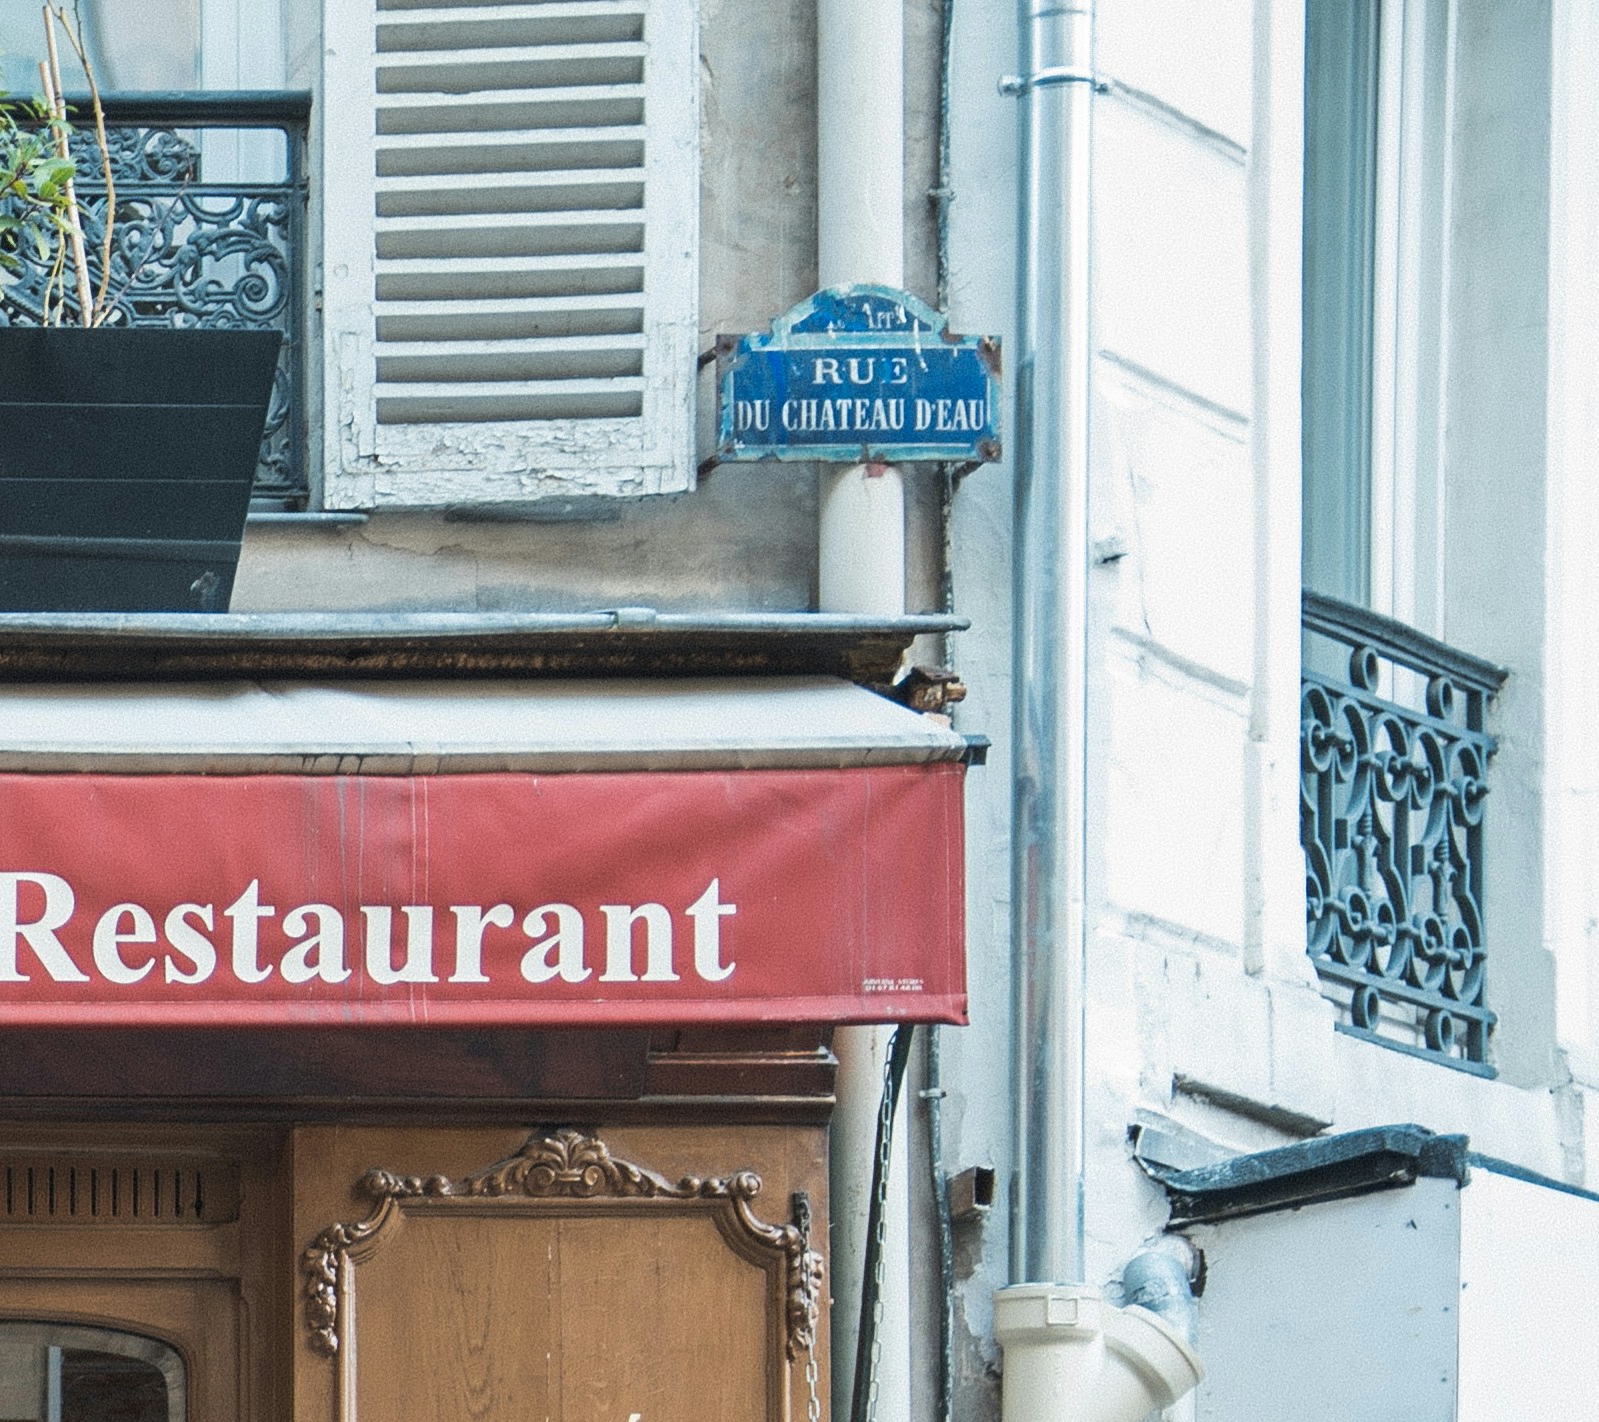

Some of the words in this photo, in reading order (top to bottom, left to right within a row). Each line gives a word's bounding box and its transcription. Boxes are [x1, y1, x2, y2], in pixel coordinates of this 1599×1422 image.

[812, 357, 907, 384] RUE
[737, 399, 770, 432] DU
[782, 398, 904, 432] CHATEAU
[914, 398, 985, 432] D'EAU
